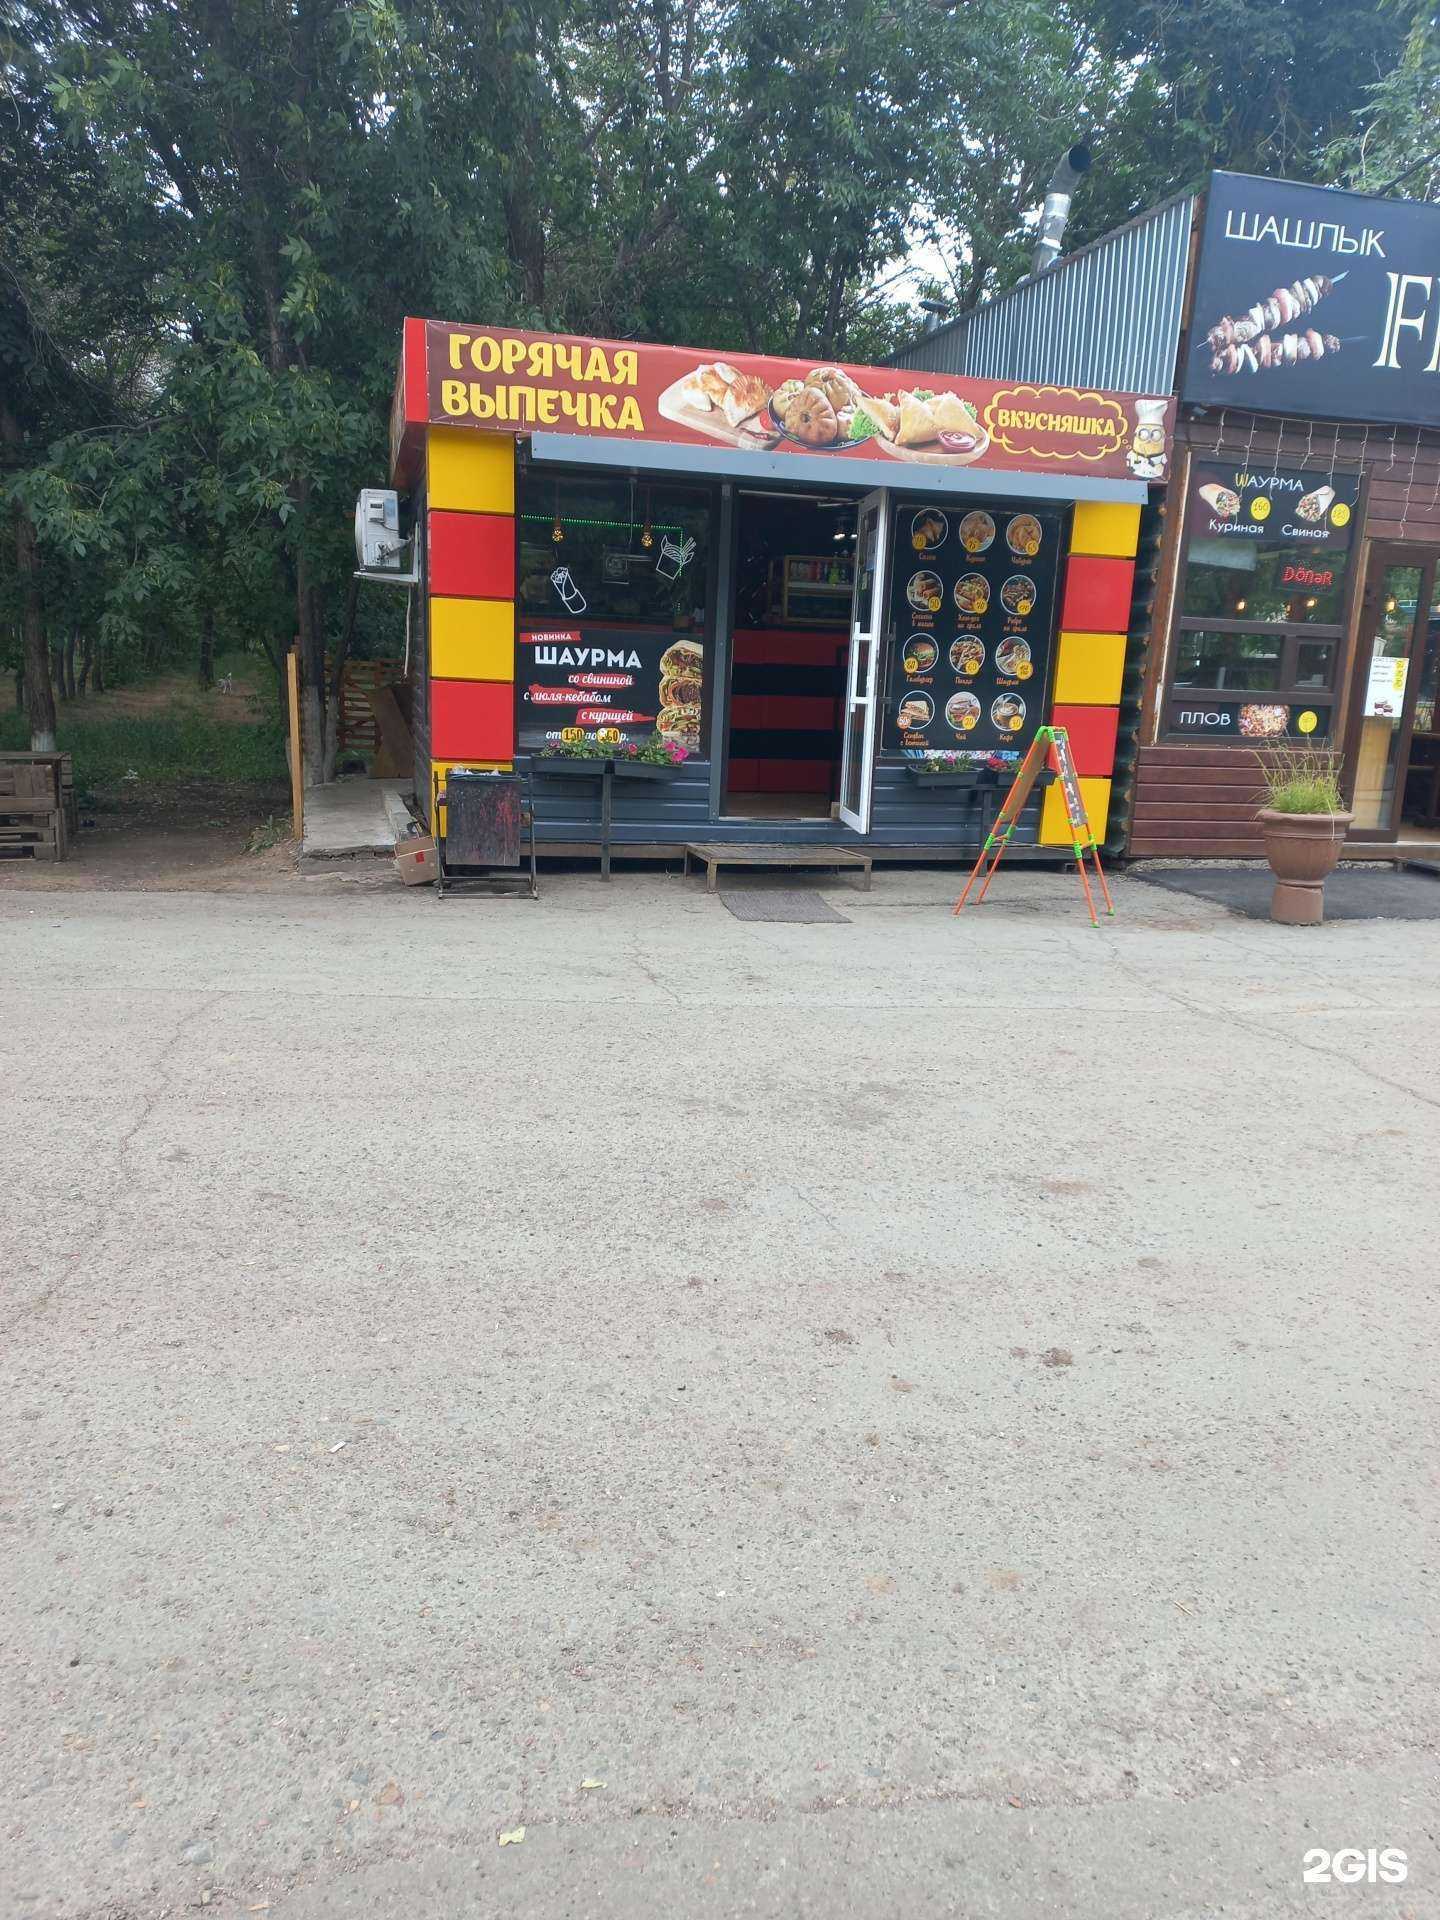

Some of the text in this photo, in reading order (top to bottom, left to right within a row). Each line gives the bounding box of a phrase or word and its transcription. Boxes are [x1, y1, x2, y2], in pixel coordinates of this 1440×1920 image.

[1225, 210, 1386, 258] ШАШЛЫК
[449, 333, 638, 386] ГОРЯЧАЯ
[441, 379, 645, 431] ВЫПЕЧКА
[997, 409, 1116, 437] ВКУСНЯШКА
[1208, 518, 1264, 534] Куриная
[1281, 524, 1330, 538] Свиная
[531, 633, 572, 641] НОВИНКА
[534, 645, 642, 669] ШАУРМА
[568, 674, 633, 686] со свининой
[523, 690, 611, 703] с люля-кебабом
[581, 710, 634, 724] с курицей
[1180, 711, 1231, 725] ПЛОВ
